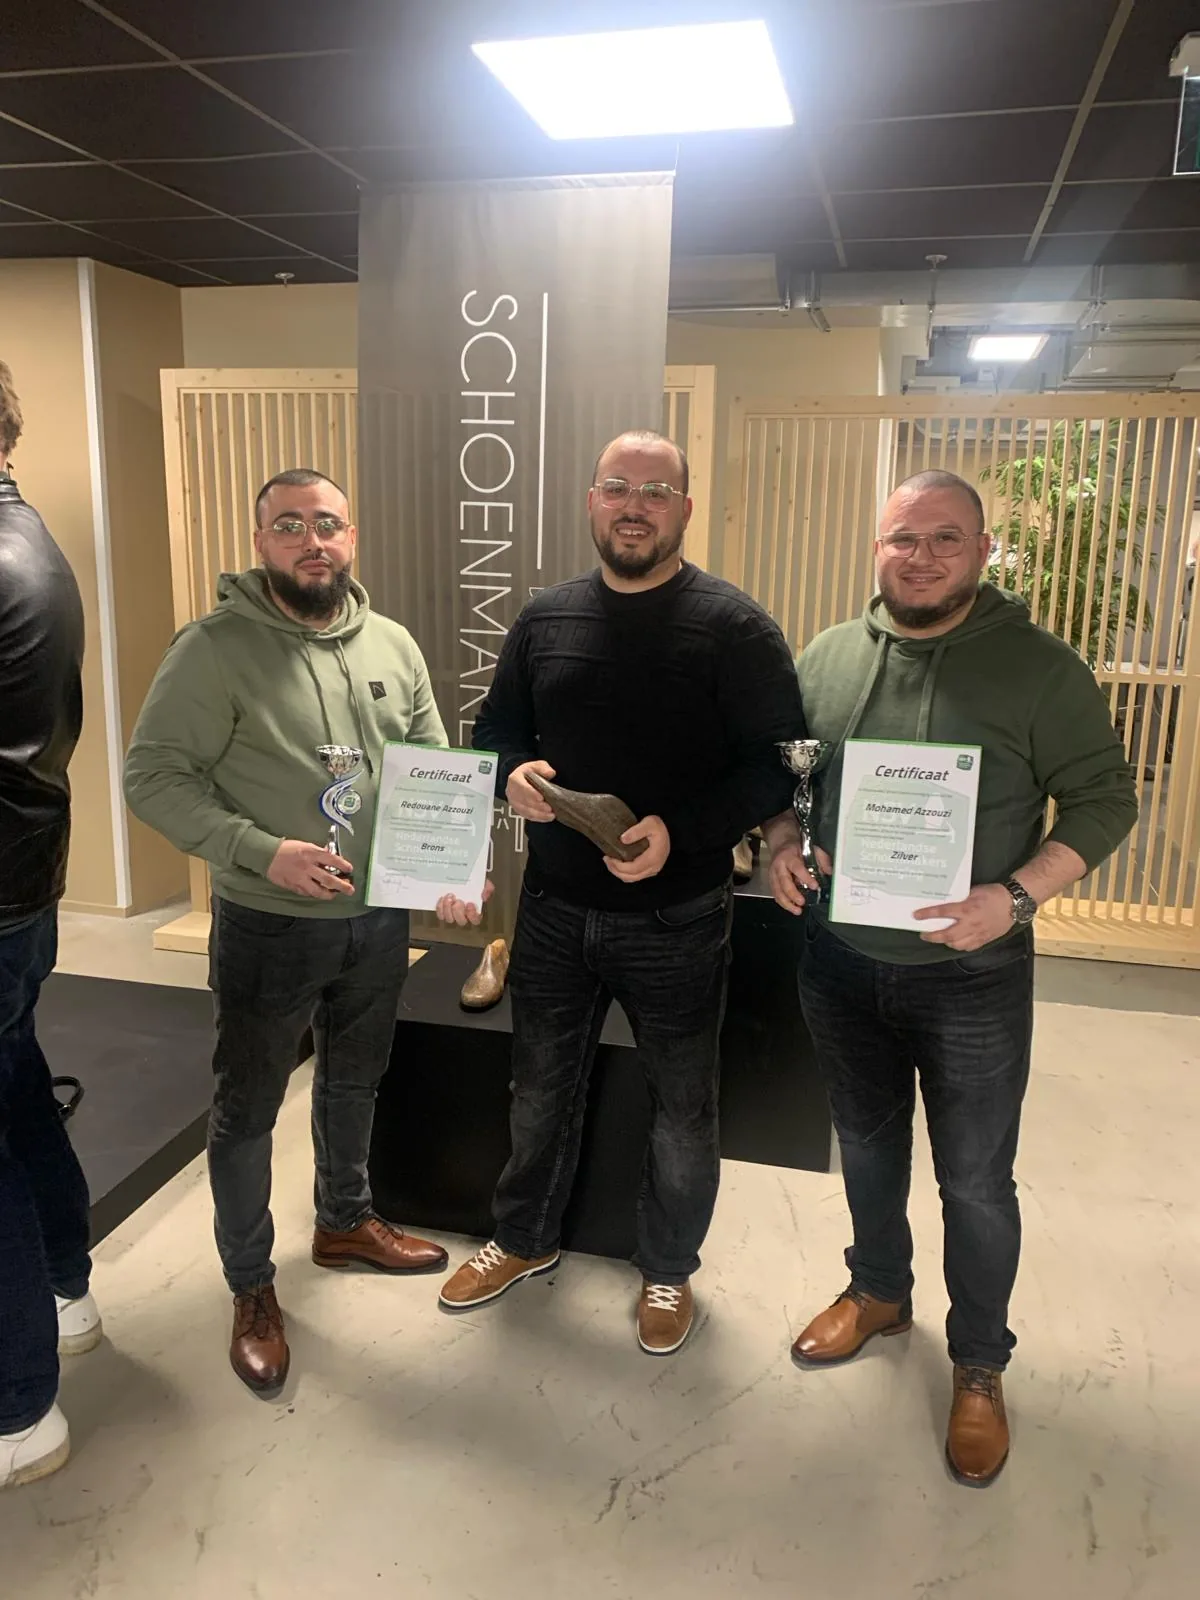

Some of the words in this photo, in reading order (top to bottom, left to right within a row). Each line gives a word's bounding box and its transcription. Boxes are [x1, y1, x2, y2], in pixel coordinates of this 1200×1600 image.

[409, 767, 472, 784] Certificaat
[875, 765, 950, 782] Certificaat
[400, 800, 441, 811] Redouane
[442, 804, 474, 815] Azzouzi
[865, 803, 913, 815] Mohamed
[914, 807, 953, 818] Azzouzi
[420, 842, 445, 852] Brons
[890, 850, 919, 861] Zilver
